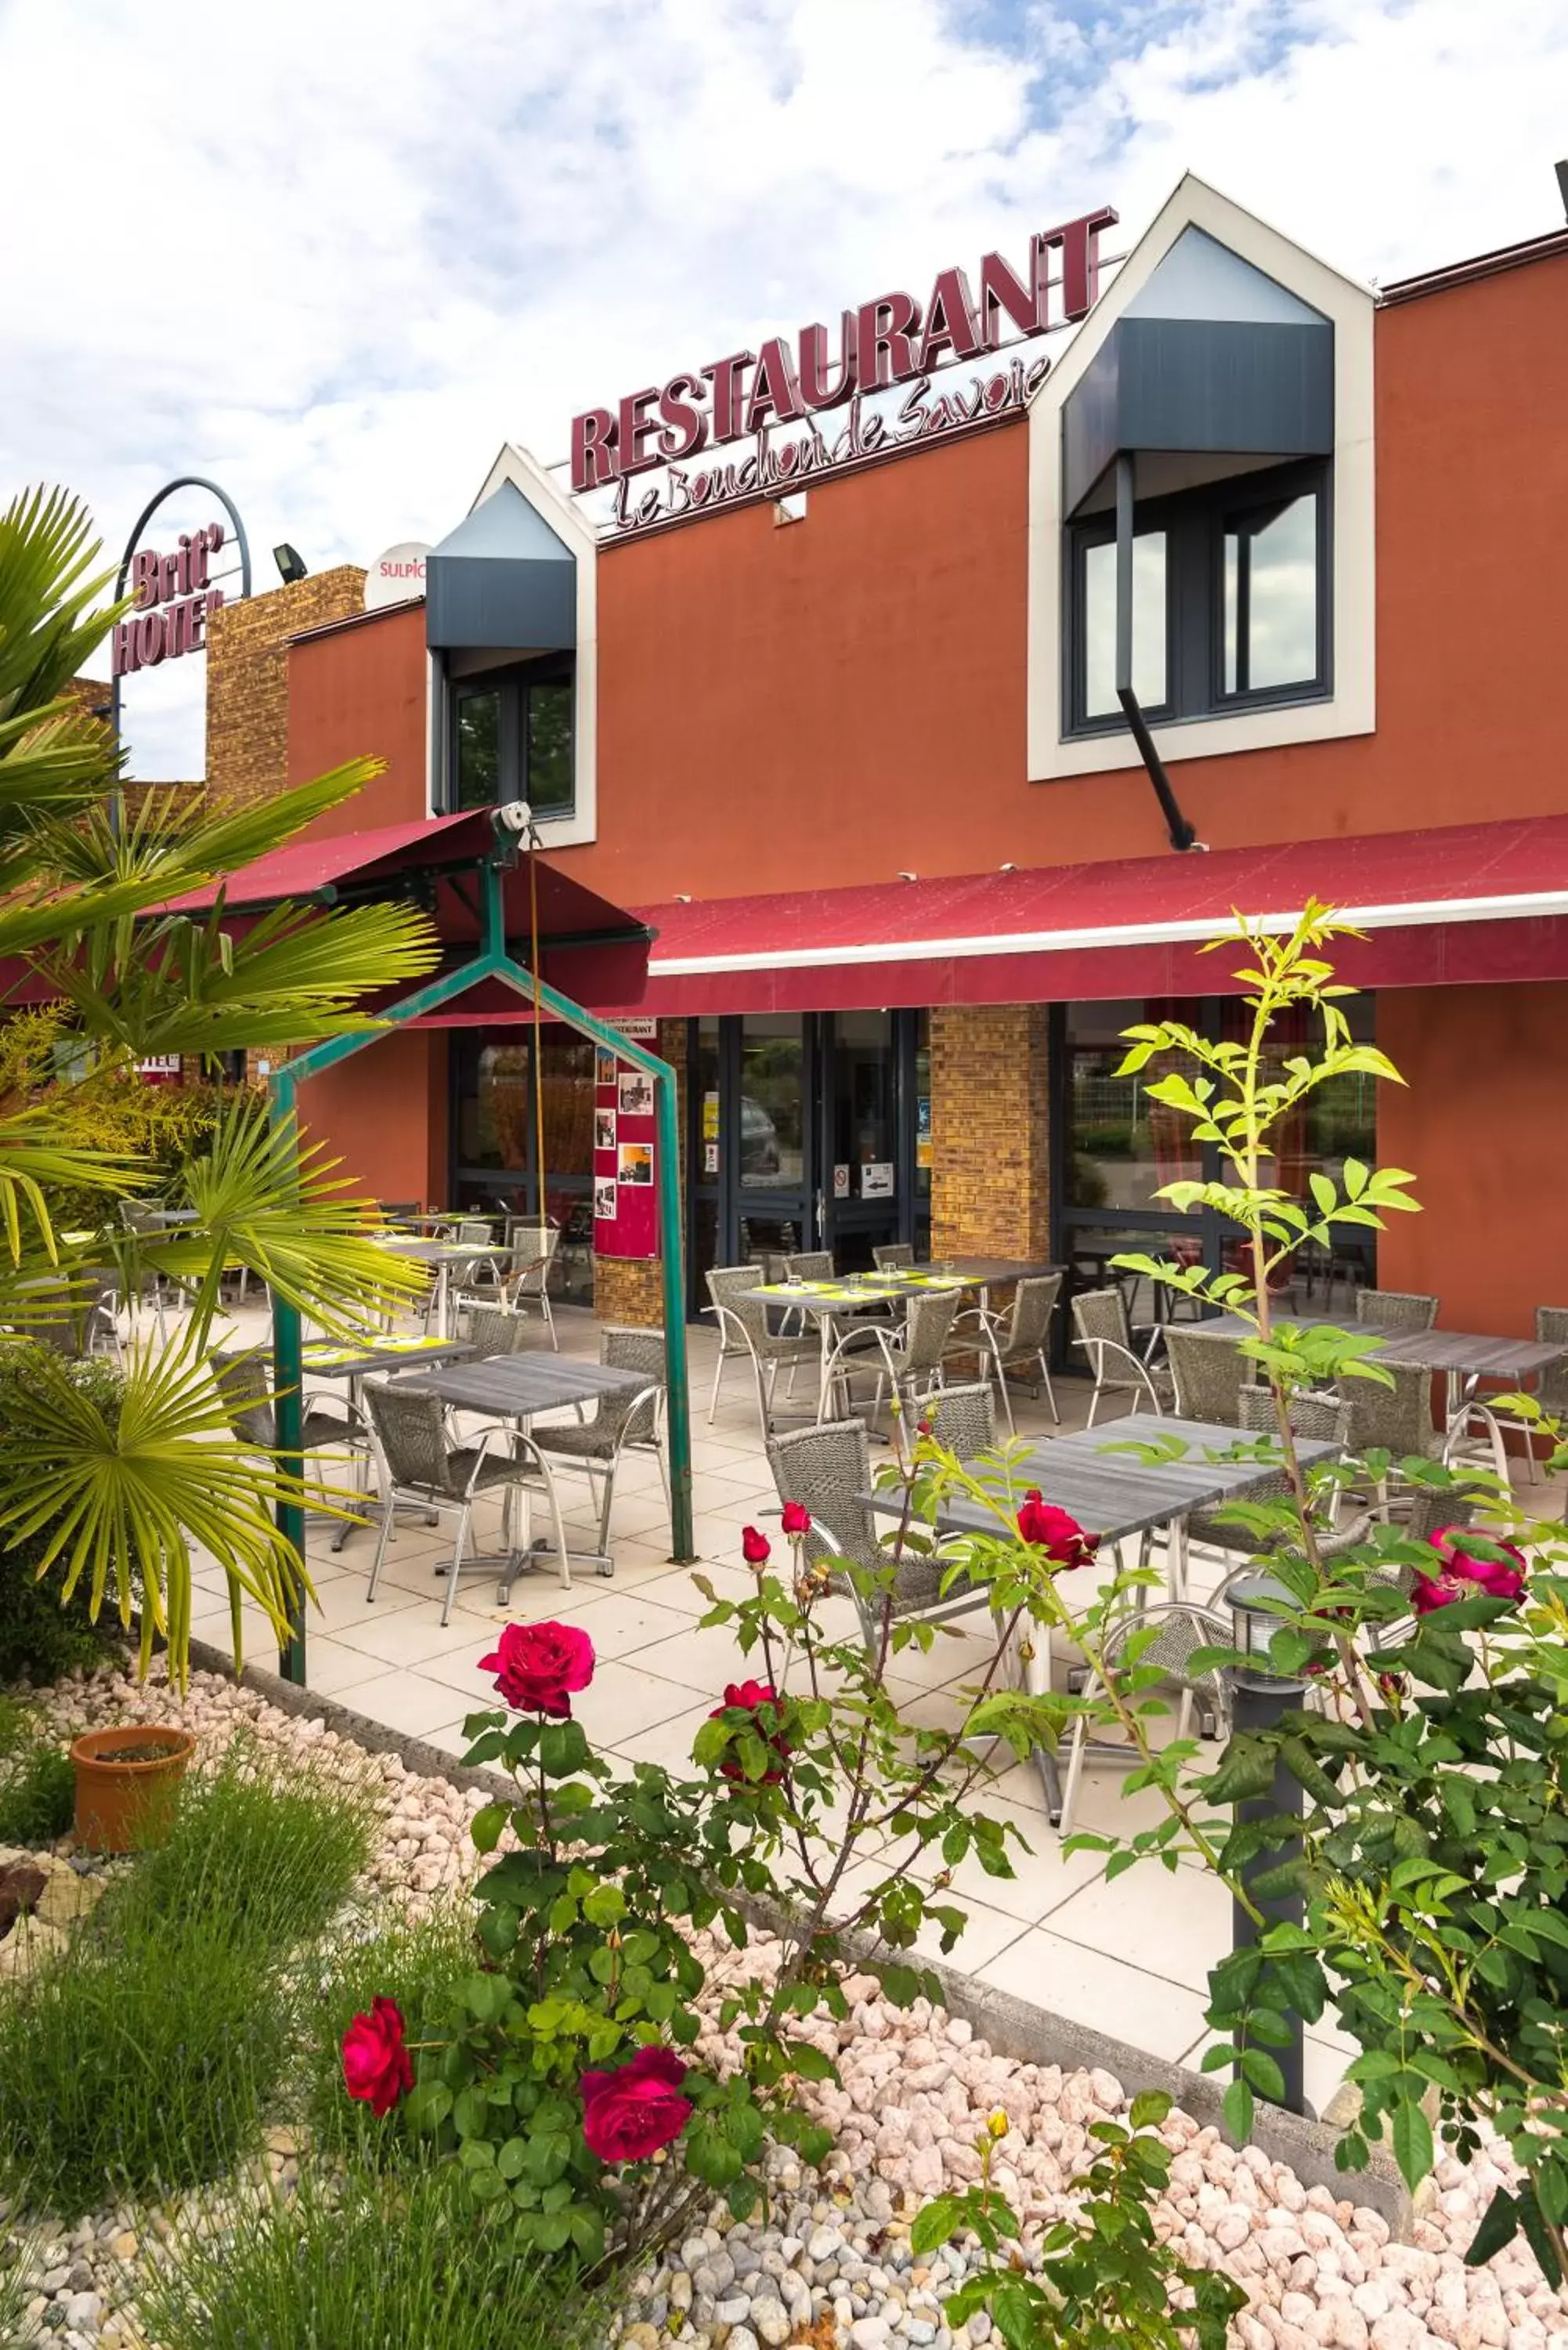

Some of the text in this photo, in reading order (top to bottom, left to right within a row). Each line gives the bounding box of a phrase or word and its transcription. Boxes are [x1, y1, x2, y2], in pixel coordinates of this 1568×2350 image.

[570, 205, 1119, 494] RESTAURANT
[612, 354, 1051, 530] Le Bouchon de Savoie
